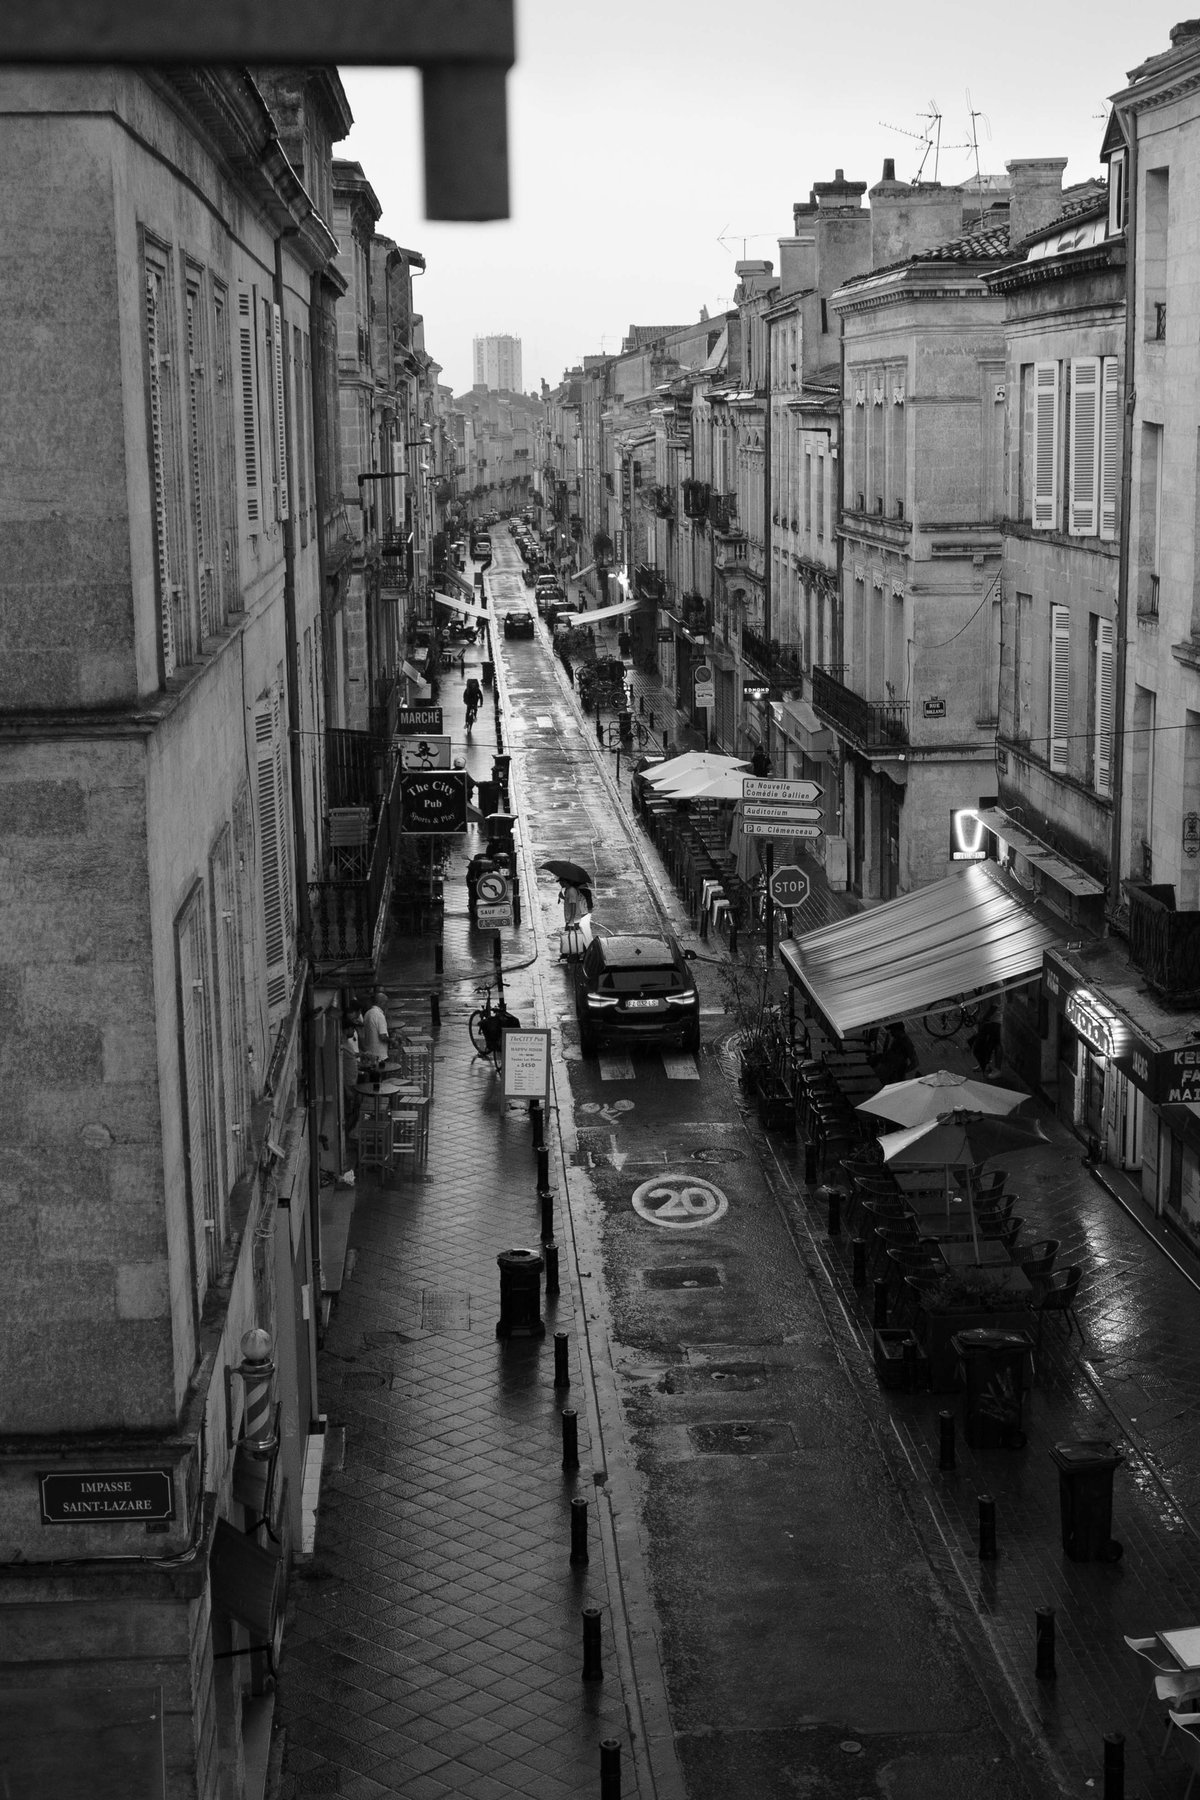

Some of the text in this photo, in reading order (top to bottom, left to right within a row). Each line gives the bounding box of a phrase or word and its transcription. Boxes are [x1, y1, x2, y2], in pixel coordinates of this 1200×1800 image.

[400, 710, 440, 724] MARCHÉ
[407, 780, 455, 796] The City
[757, 782, 791, 791] Nouvelle
[746, 789, 810, 799] Comédie Gallien
[424, 799, 442, 808] Pub
[410, 811, 431, 824] Sports
[746, 808, 788, 816] Auditorium
[767, 826, 813, 835] Clémenceau
[774, 880, 805, 893] STOP
[648, 1187, 716, 1217] 20
[81, 1481, 132, 1493] IMPASSE
[63, 1499, 152, 1513] SAINT-LAZARE
